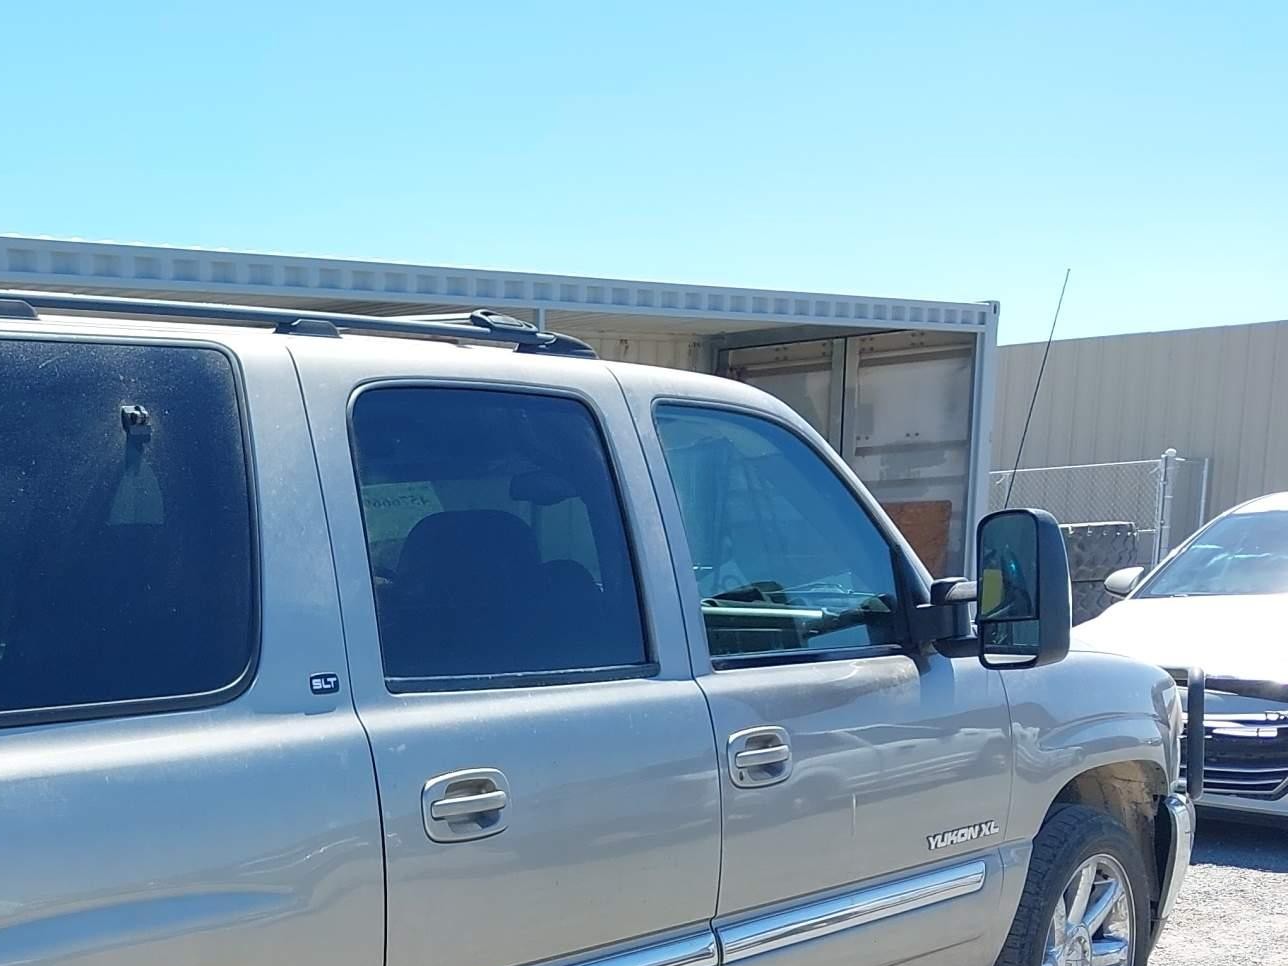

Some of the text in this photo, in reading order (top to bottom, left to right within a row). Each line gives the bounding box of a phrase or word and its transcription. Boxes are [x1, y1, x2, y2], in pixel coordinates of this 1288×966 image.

[312, 677, 337, 689] SLT
[927, 820, 999, 850] YUKON XL
